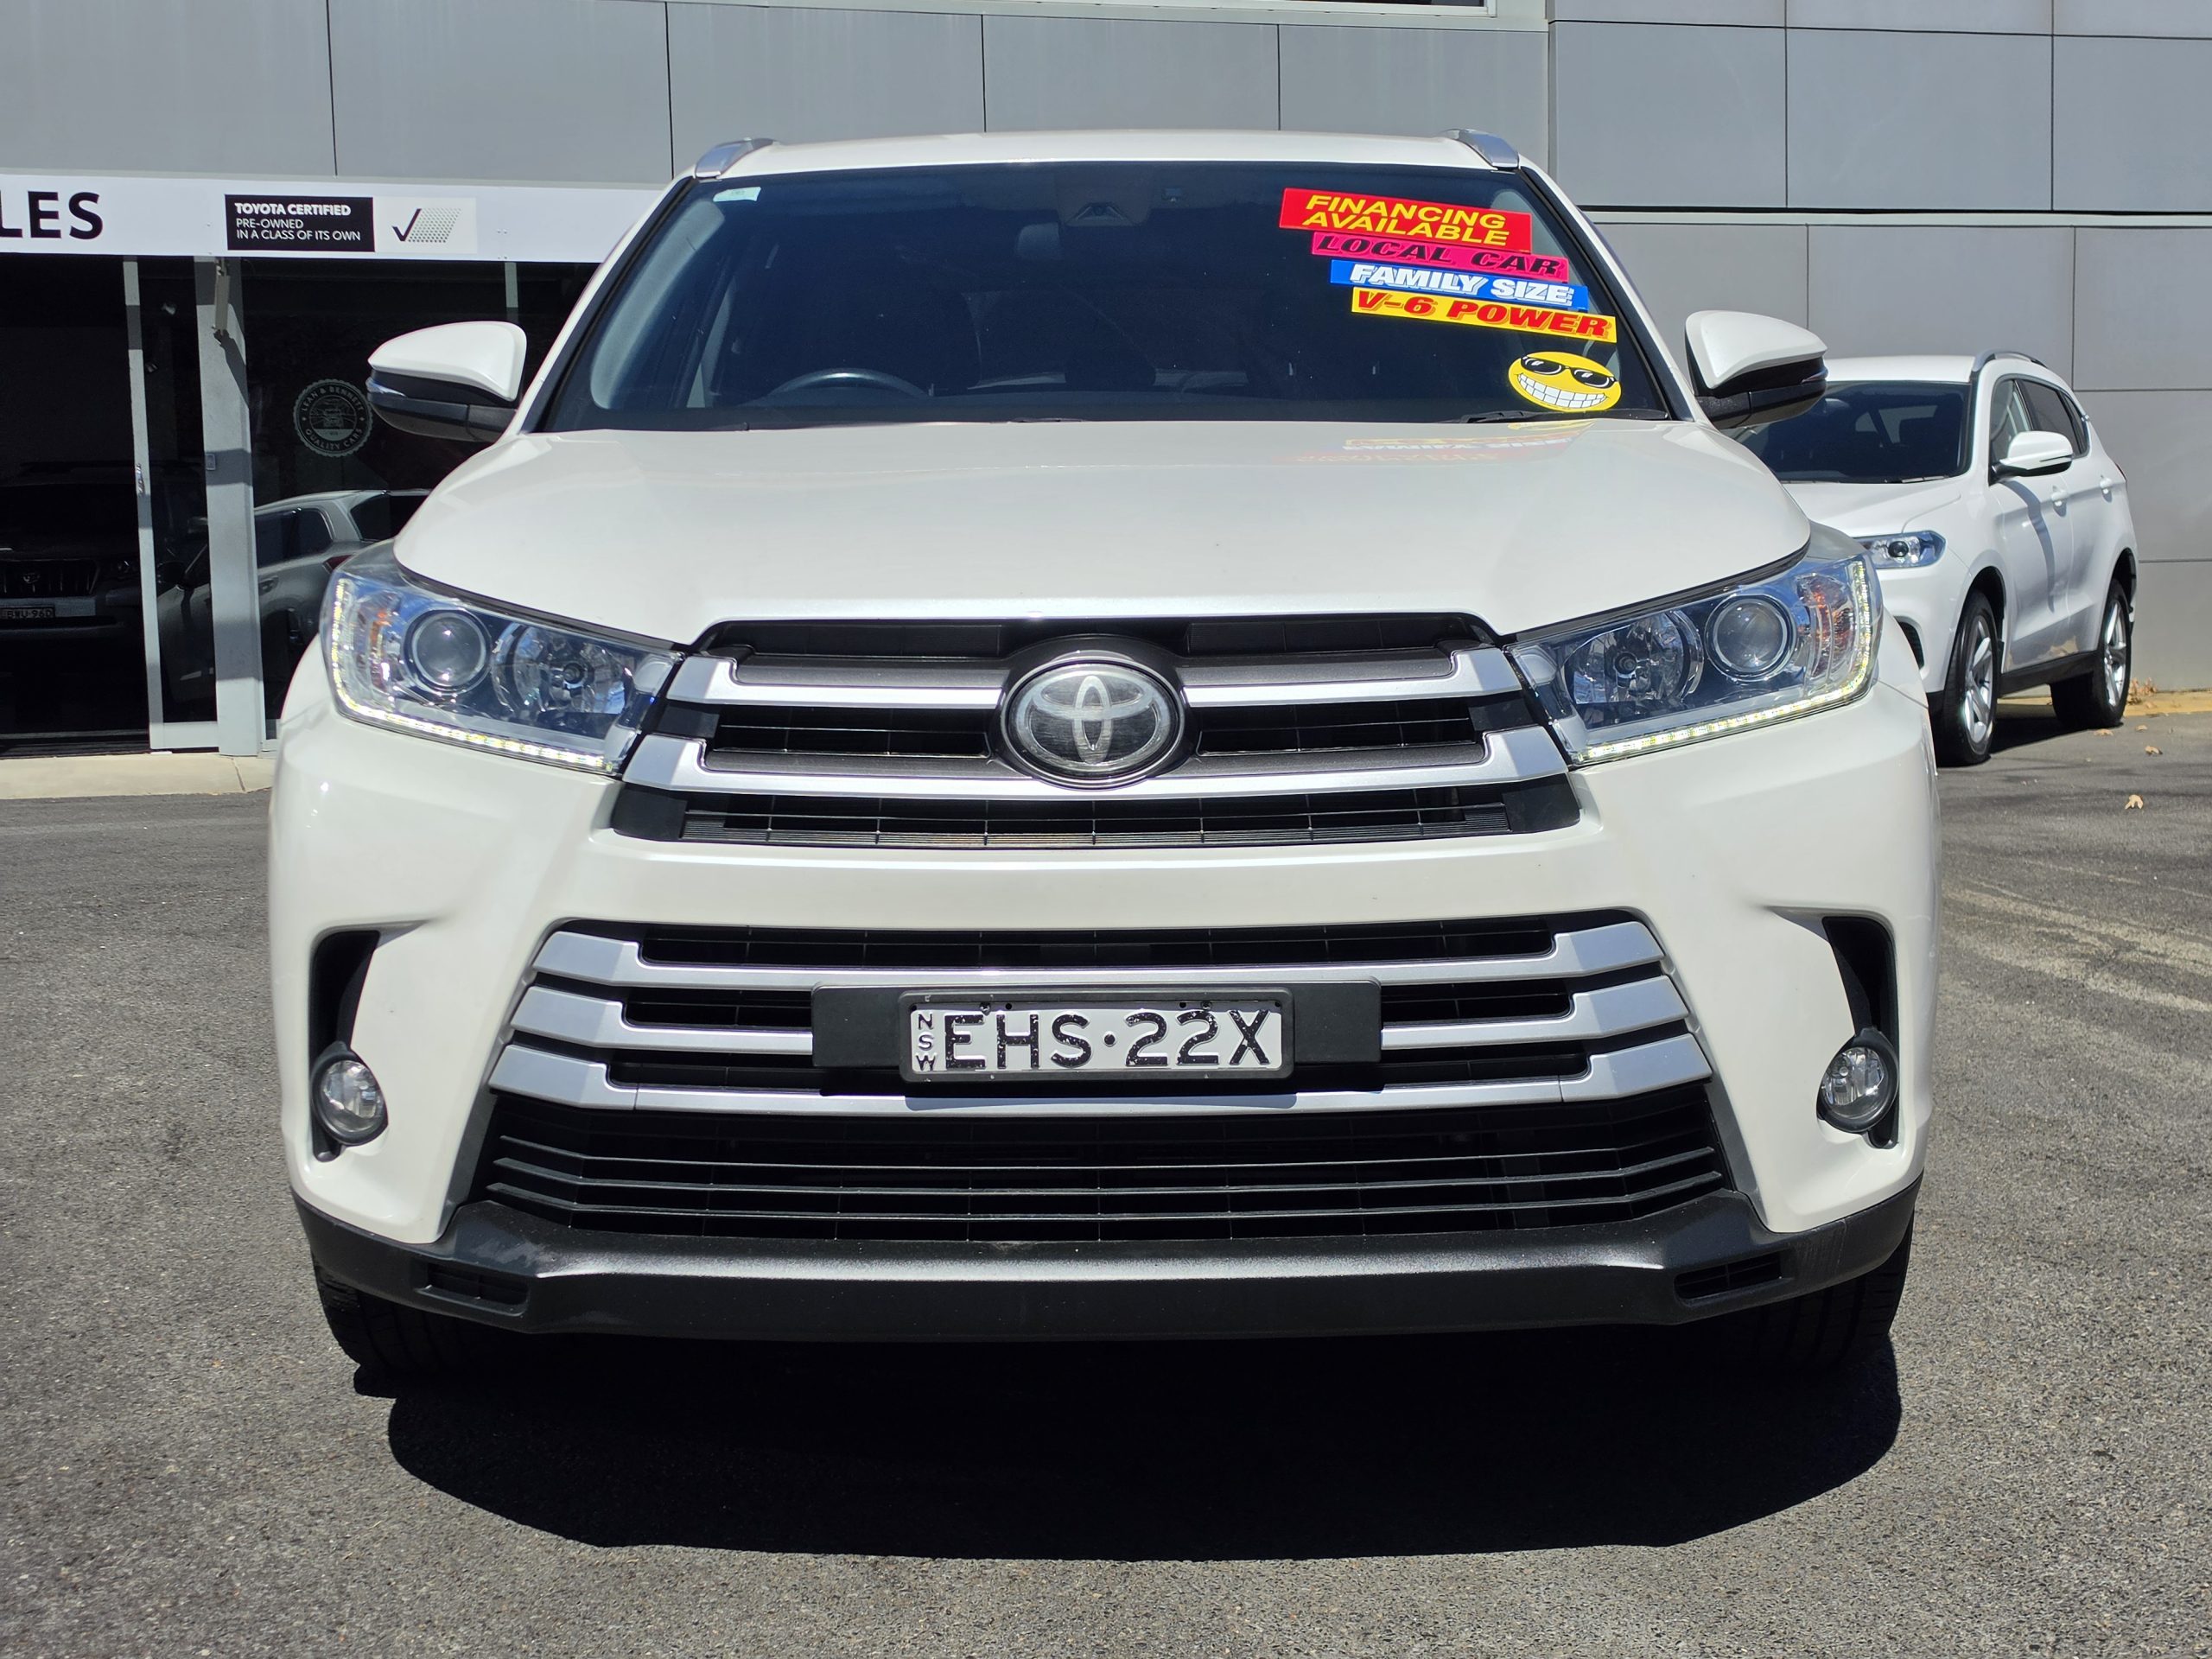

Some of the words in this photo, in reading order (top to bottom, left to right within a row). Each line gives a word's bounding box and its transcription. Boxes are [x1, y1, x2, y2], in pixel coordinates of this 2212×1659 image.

[234, 202, 287, 215] TOYOTA
[287, 203, 352, 216] CERTIFIED
[235, 218, 304, 229] PRE-OWNED
[1306, 194, 1507, 229] FINANCING
[236, 229, 249, 239] IN
[250, 230, 259, 239] A
[260, 230, 295, 240] CLASS
[296, 230, 313, 240] OF
[315, 230, 330, 241] ITS
[332, 231, 361, 241] OWN
[1301, 211, 1510, 246] AVAILABLE
[1316, 234, 1457, 264] LOCAL
[1470, 251, 1564, 276] CAR
[1350, 263, 1488, 296] FAMILY
[1490, 276, 1575, 307] SIZE
[1357, 289, 1436, 317] V-6
[1446, 300, 1612, 339] POWER
[305, 429, 340, 449] QUALITY
[343, 428, 363, 447] CARS
[916, 1013, 936, 1071] NSW
